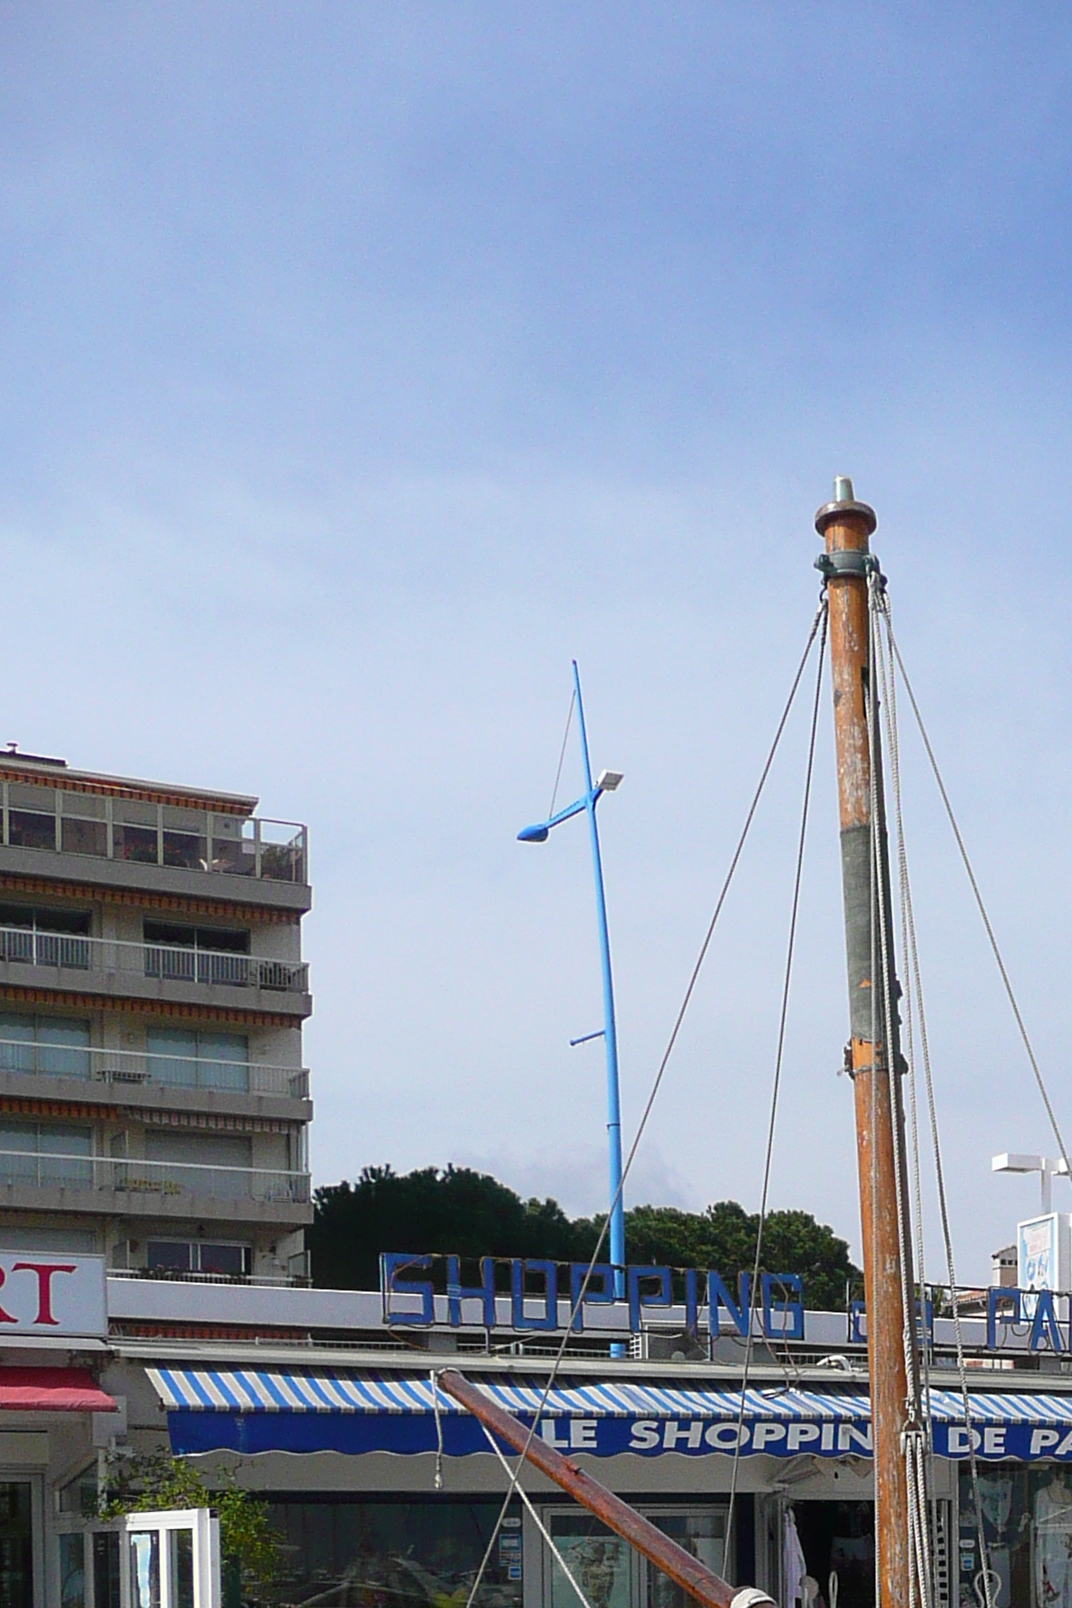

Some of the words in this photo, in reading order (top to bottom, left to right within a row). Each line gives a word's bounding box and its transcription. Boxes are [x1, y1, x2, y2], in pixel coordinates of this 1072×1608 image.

[384, 1252, 805, 1339] SHOPPING
[540, 1418, 598, 1449] LE
[629, 1420, 874, 1451] SHOPPIN
[947, 1426, 1007, 1454] DE
